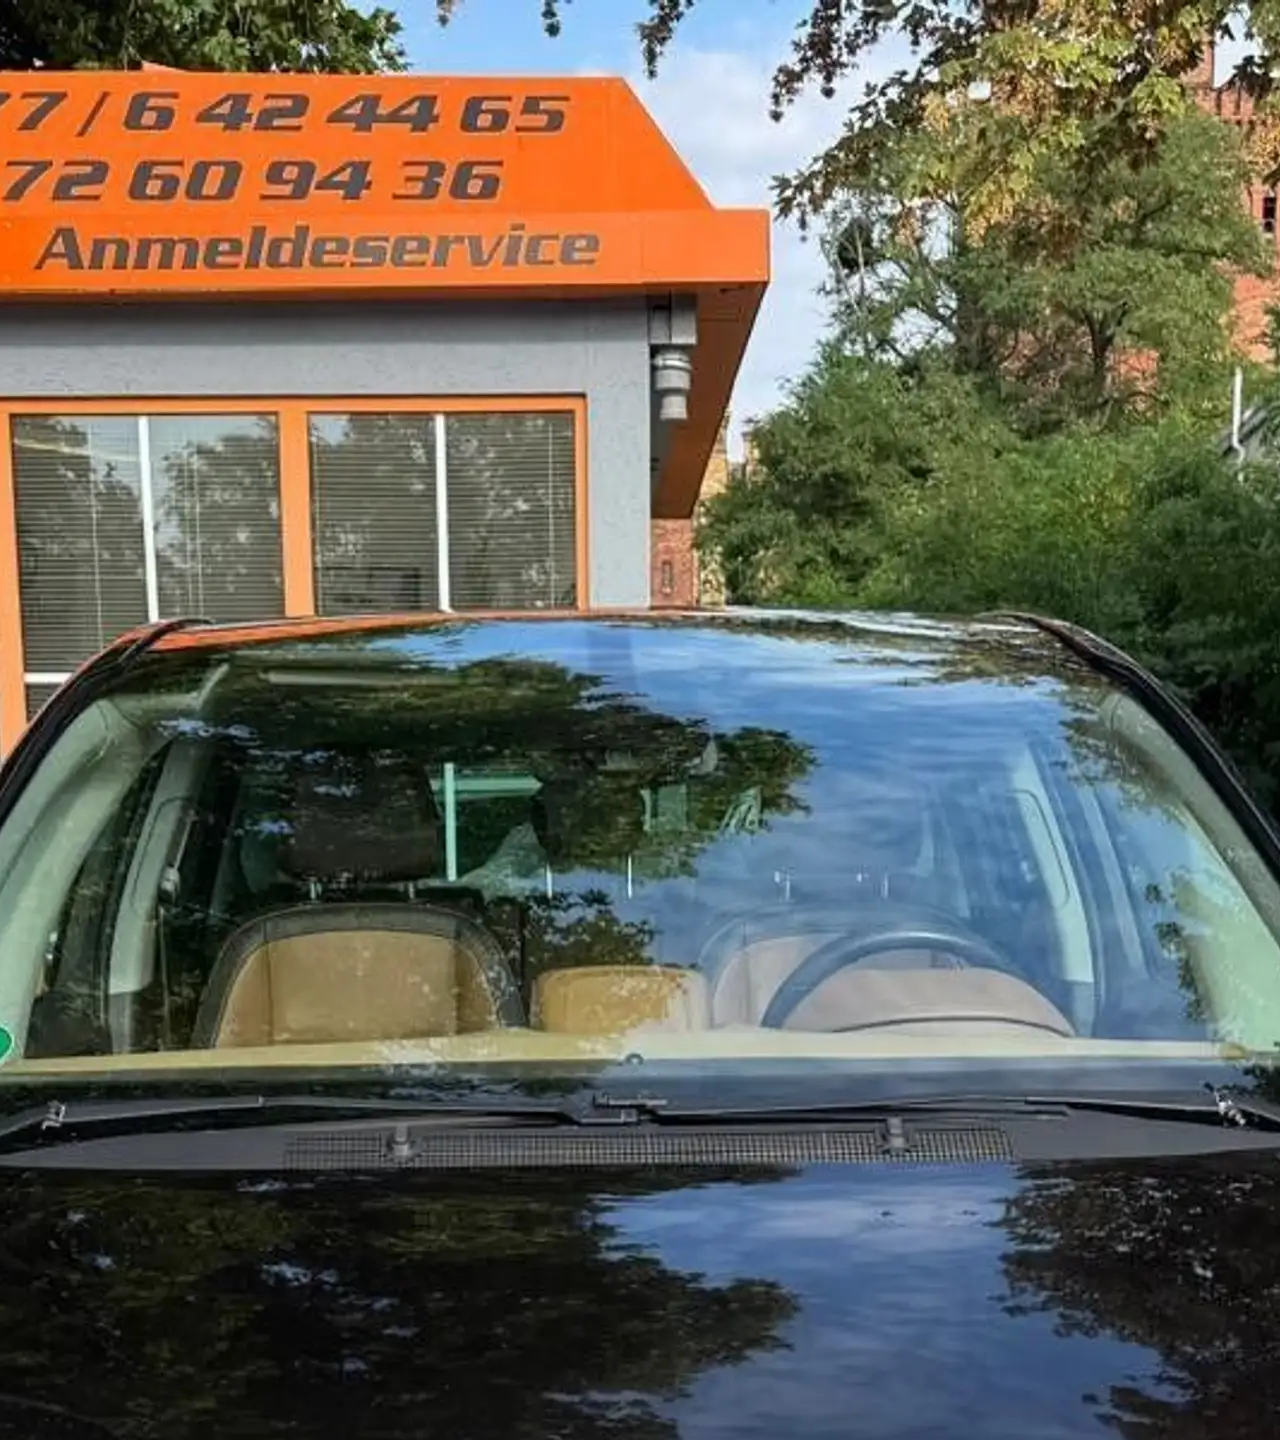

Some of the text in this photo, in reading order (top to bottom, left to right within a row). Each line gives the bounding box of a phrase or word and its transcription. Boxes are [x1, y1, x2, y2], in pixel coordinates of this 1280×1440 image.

[80, 92, 110, 137] /
[124, 92, 178, 131] 6
[197, 93, 310, 132] 42
[327, 94, 439, 133] 44
[461, 96, 569, 134] 65
[4, 160, 110, 201] 72
[129, 160, 243, 201] 60
[261, 160, 372, 201] 94
[393, 160, 503, 200] 36
[34, 225, 599, 270] Anmeldeservice
